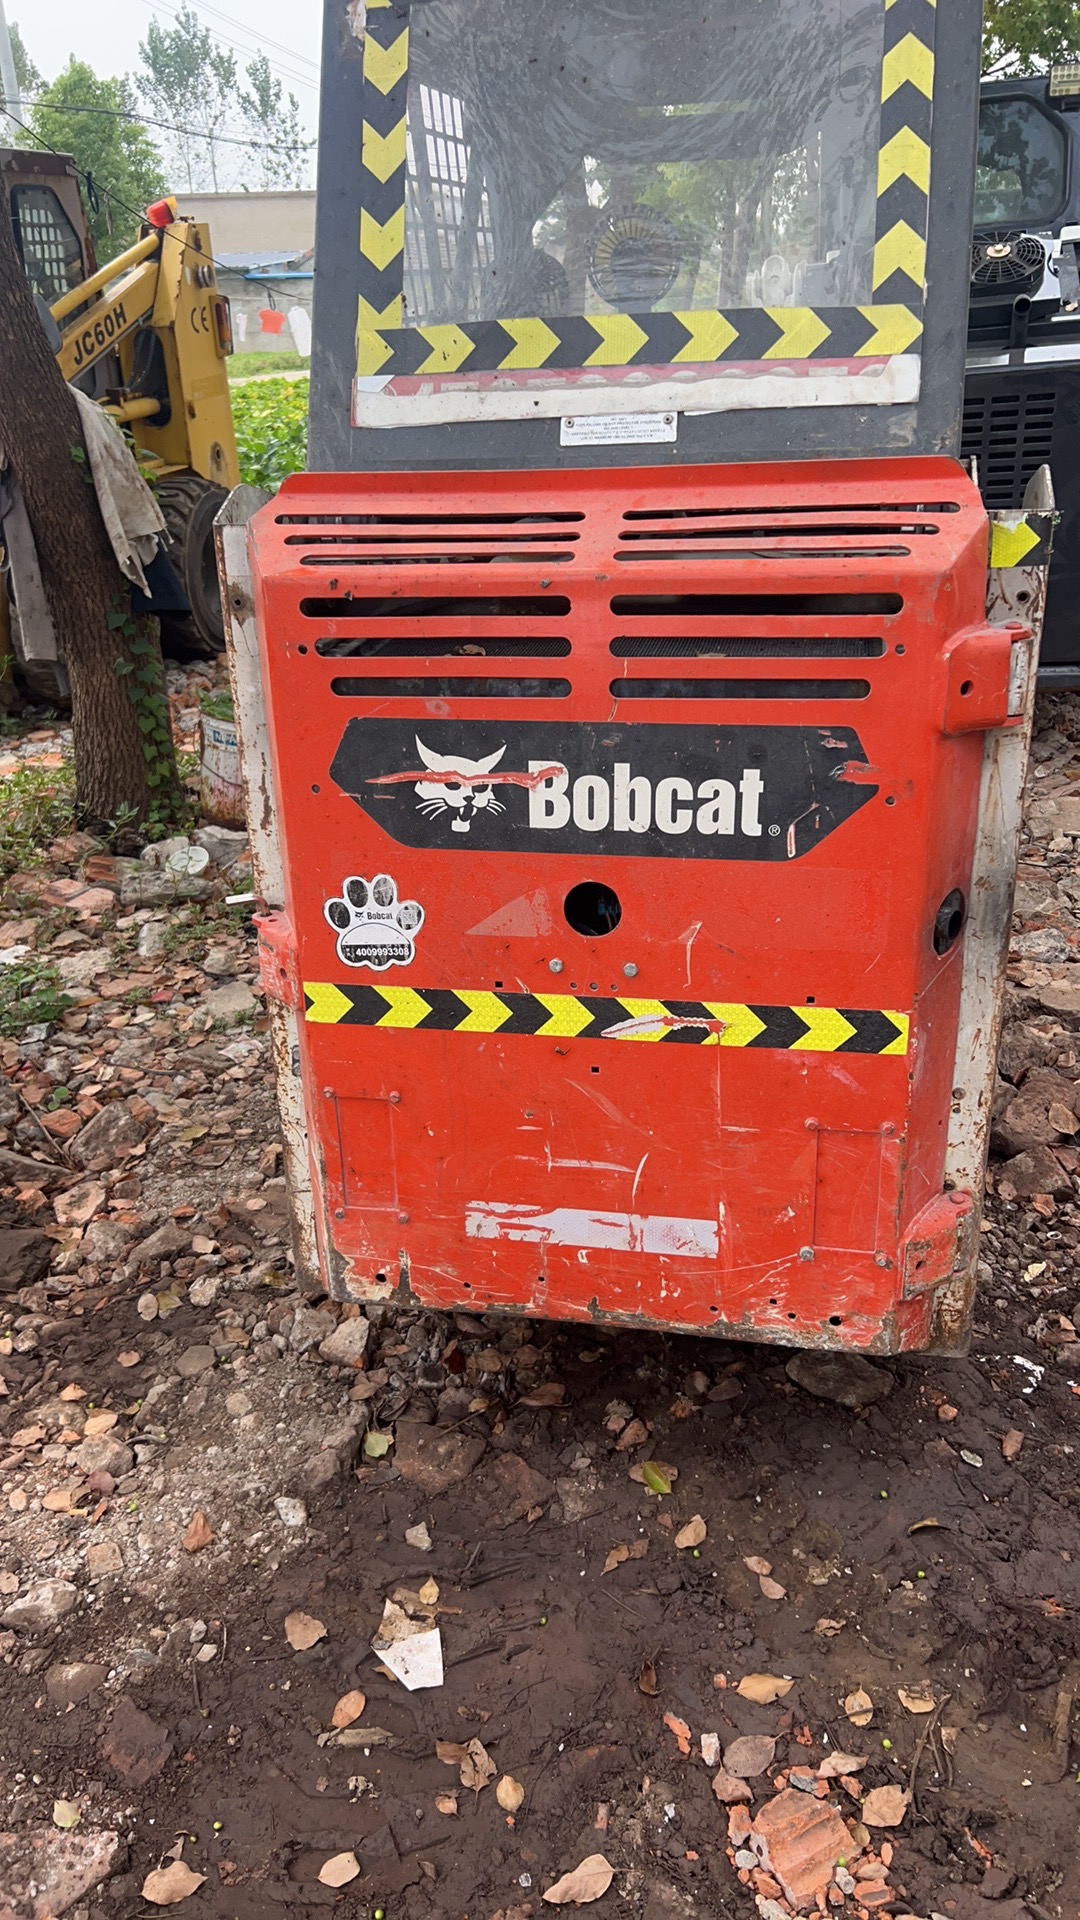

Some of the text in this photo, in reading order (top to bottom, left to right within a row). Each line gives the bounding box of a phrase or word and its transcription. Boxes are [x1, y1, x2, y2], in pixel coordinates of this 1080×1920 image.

[73, 302, 127, 366] JC60H
[528, 760, 764, 837] Bobcat
[367, 912, 393, 920] Bobcat
[356, 948, 409, 956] 4009993308
